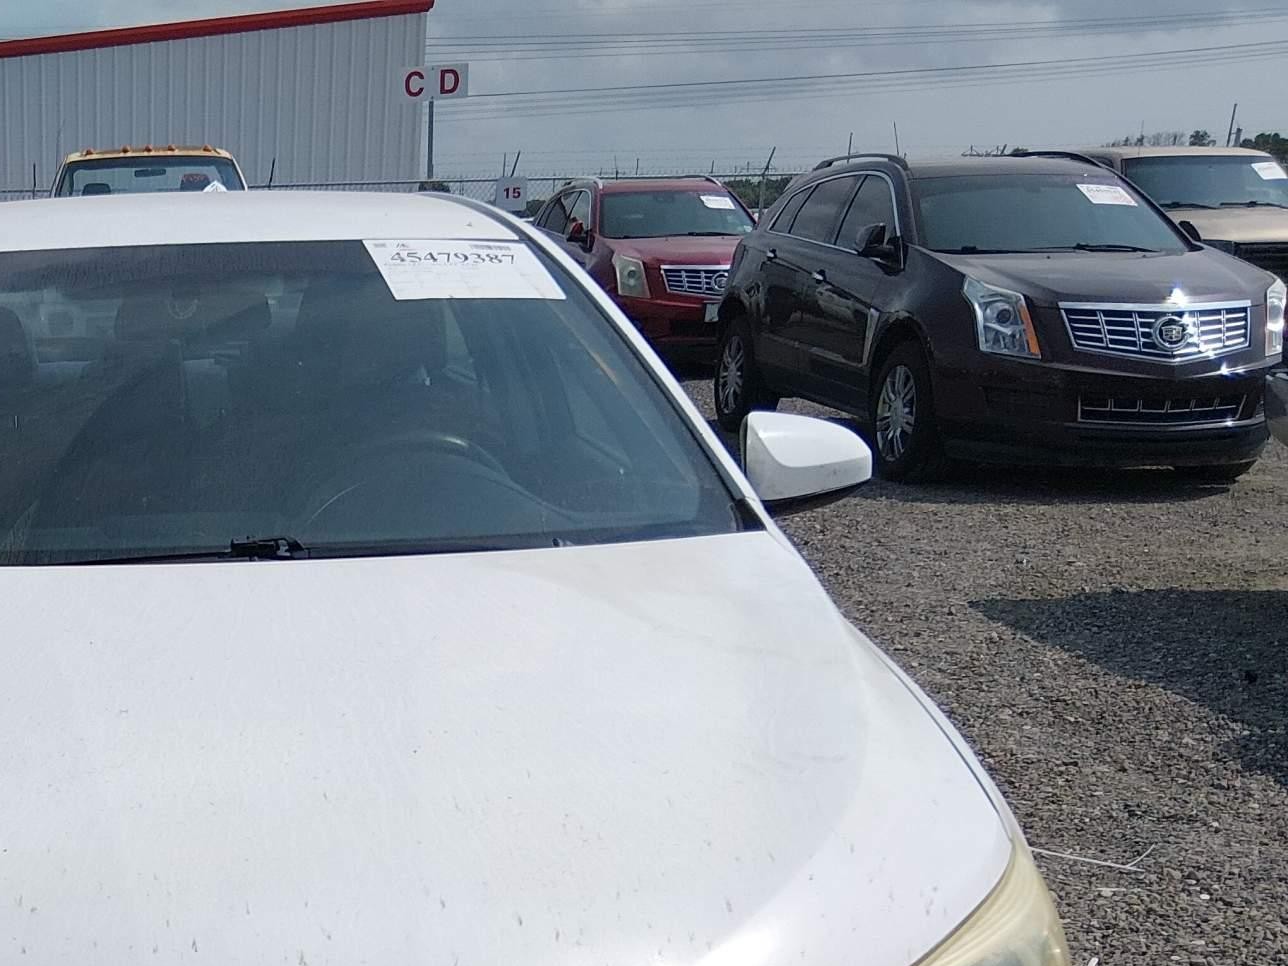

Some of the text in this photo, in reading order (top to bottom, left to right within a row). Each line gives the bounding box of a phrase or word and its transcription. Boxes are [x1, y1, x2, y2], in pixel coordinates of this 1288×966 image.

[405, 69, 460, 97] C D
[504, 187, 521, 199] 15
[390, 252, 515, 265] 45479387
